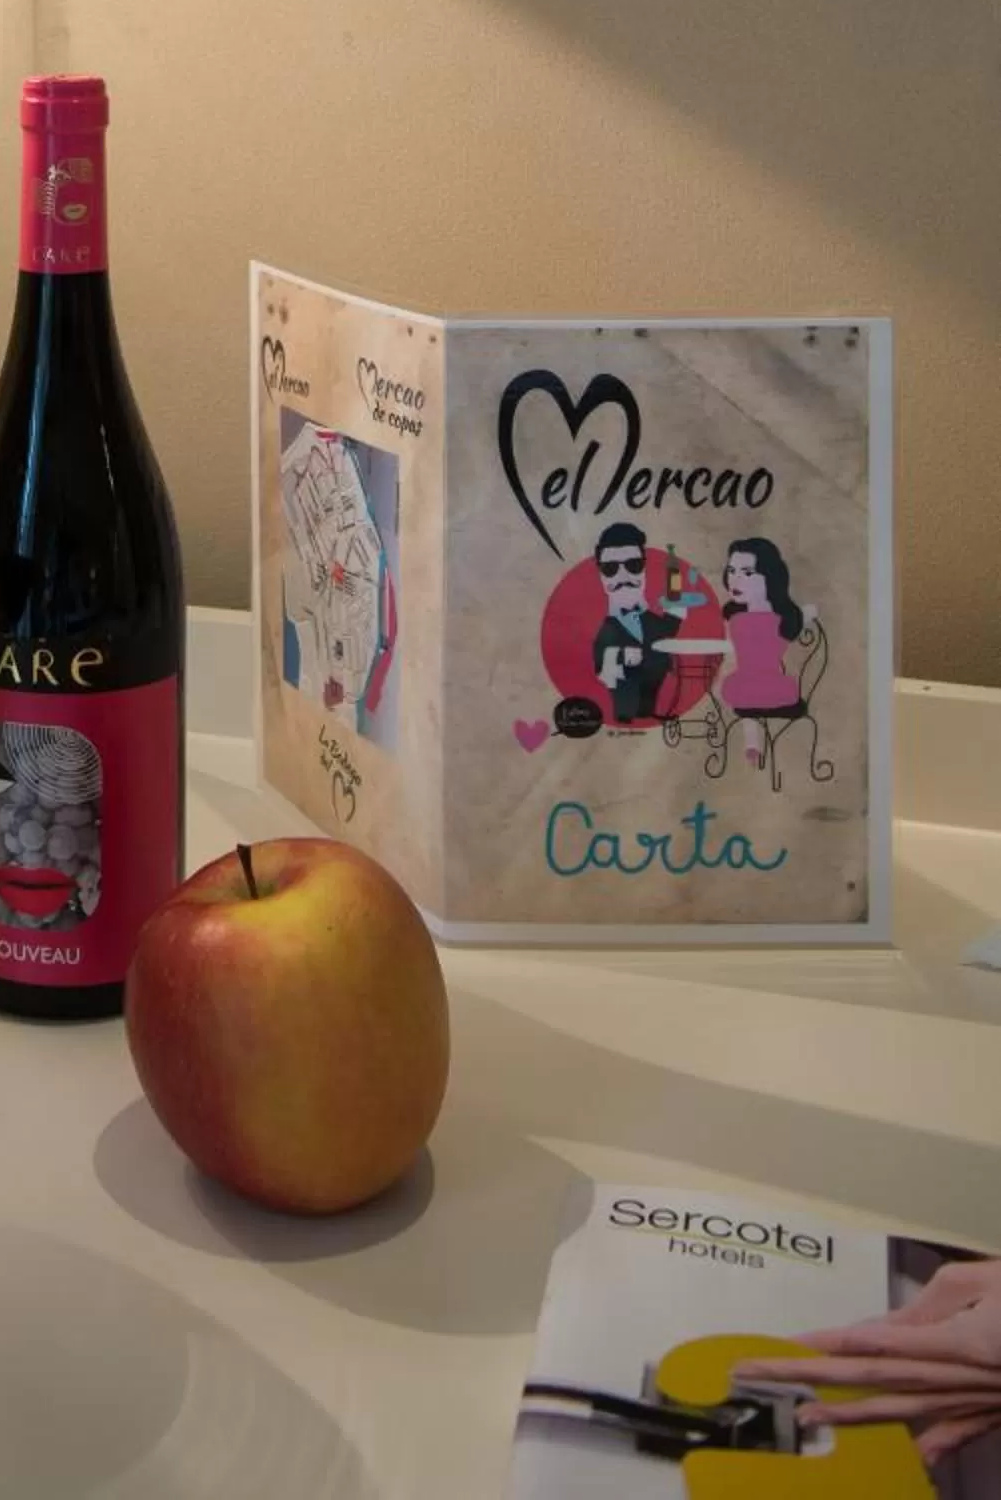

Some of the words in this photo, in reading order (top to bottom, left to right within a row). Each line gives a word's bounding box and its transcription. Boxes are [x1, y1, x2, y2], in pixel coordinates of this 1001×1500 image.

[357, 357, 426, 411] Mercao
[372, 402, 386, 423] de
[545, 801, 788, 876] Carta
[608, 1199, 834, 1264] Sercotel
[668, 1236, 765, 1269] hotels
